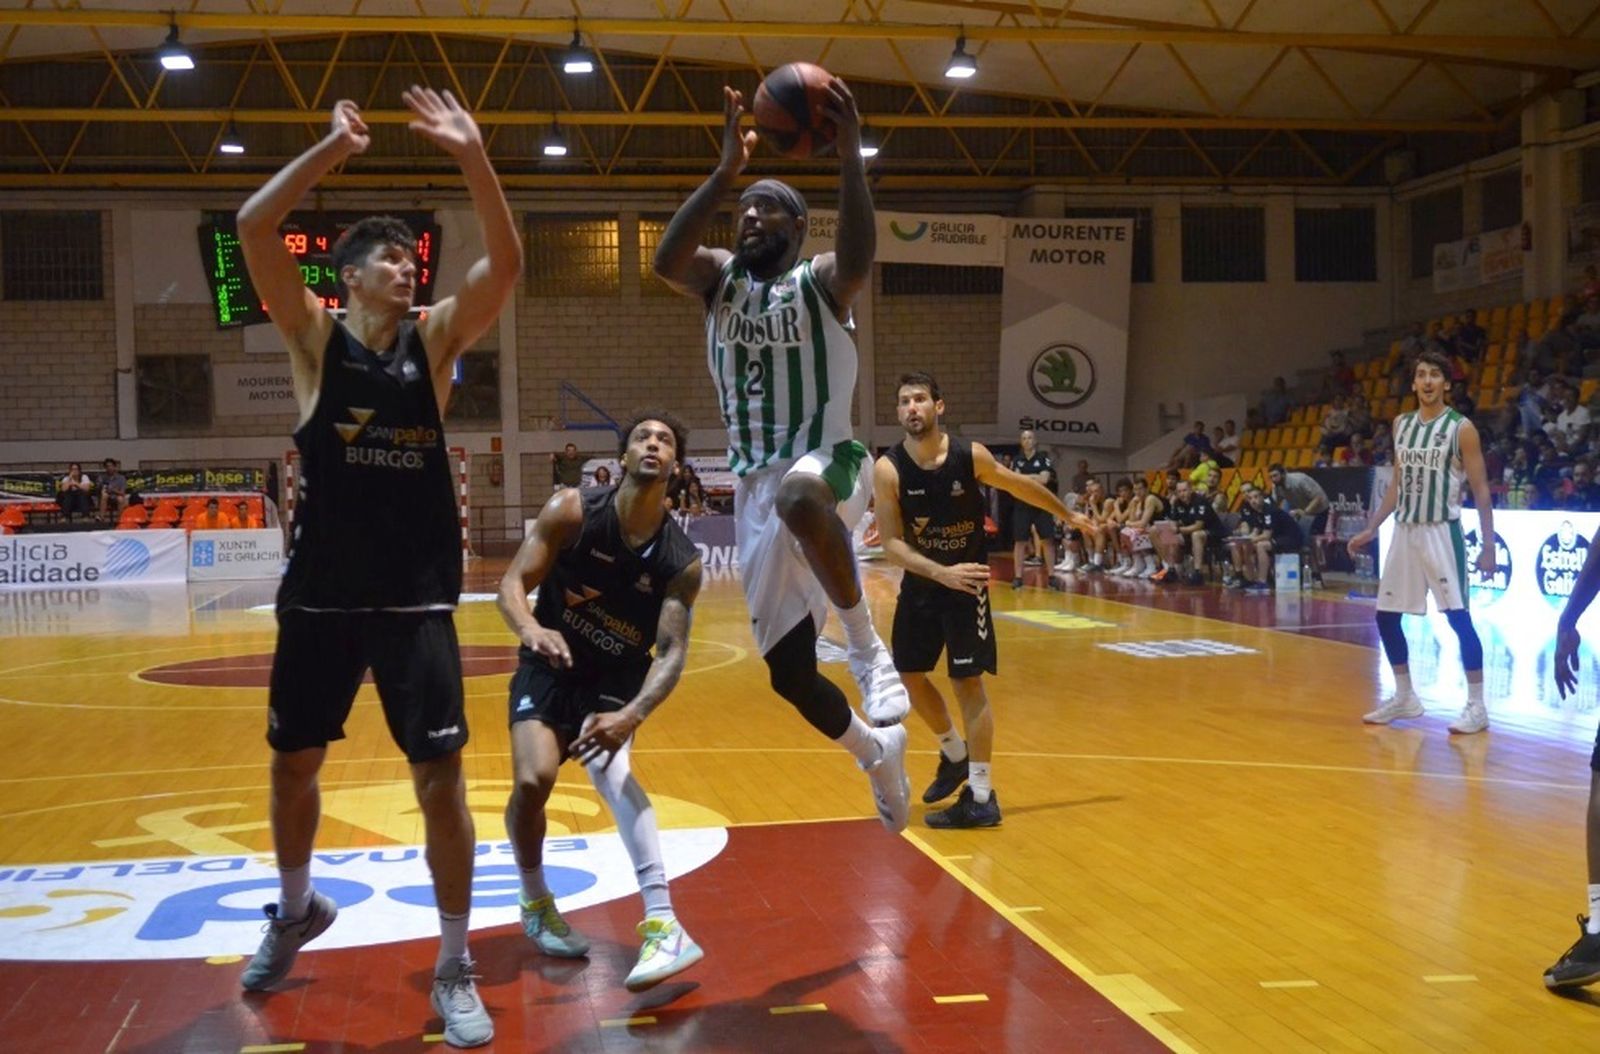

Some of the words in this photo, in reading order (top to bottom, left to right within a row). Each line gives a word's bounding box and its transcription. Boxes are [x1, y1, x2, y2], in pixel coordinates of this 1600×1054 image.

[810, 216, 840, 227] DEPO
[931, 221, 975, 233] GALICIA
[809, 227, 834, 239] GAL
[931, 232, 987, 245] SAUDABLE
[1012, 222, 1126, 242] MOURENTE
[1029, 248, 1107, 265] MOTOR
[747, 360, 764, 396] 2
[1019, 415, 1100, 434] ŠKODA
[345, 446, 424, 468] BURGOS
[0, 539, 68, 561] alicia
[219, 541, 256, 550] XUNTA
[218, 552, 232, 562] DE
[234, 551, 280, 562] GALICIA
[0, 562, 99, 583] alidade
